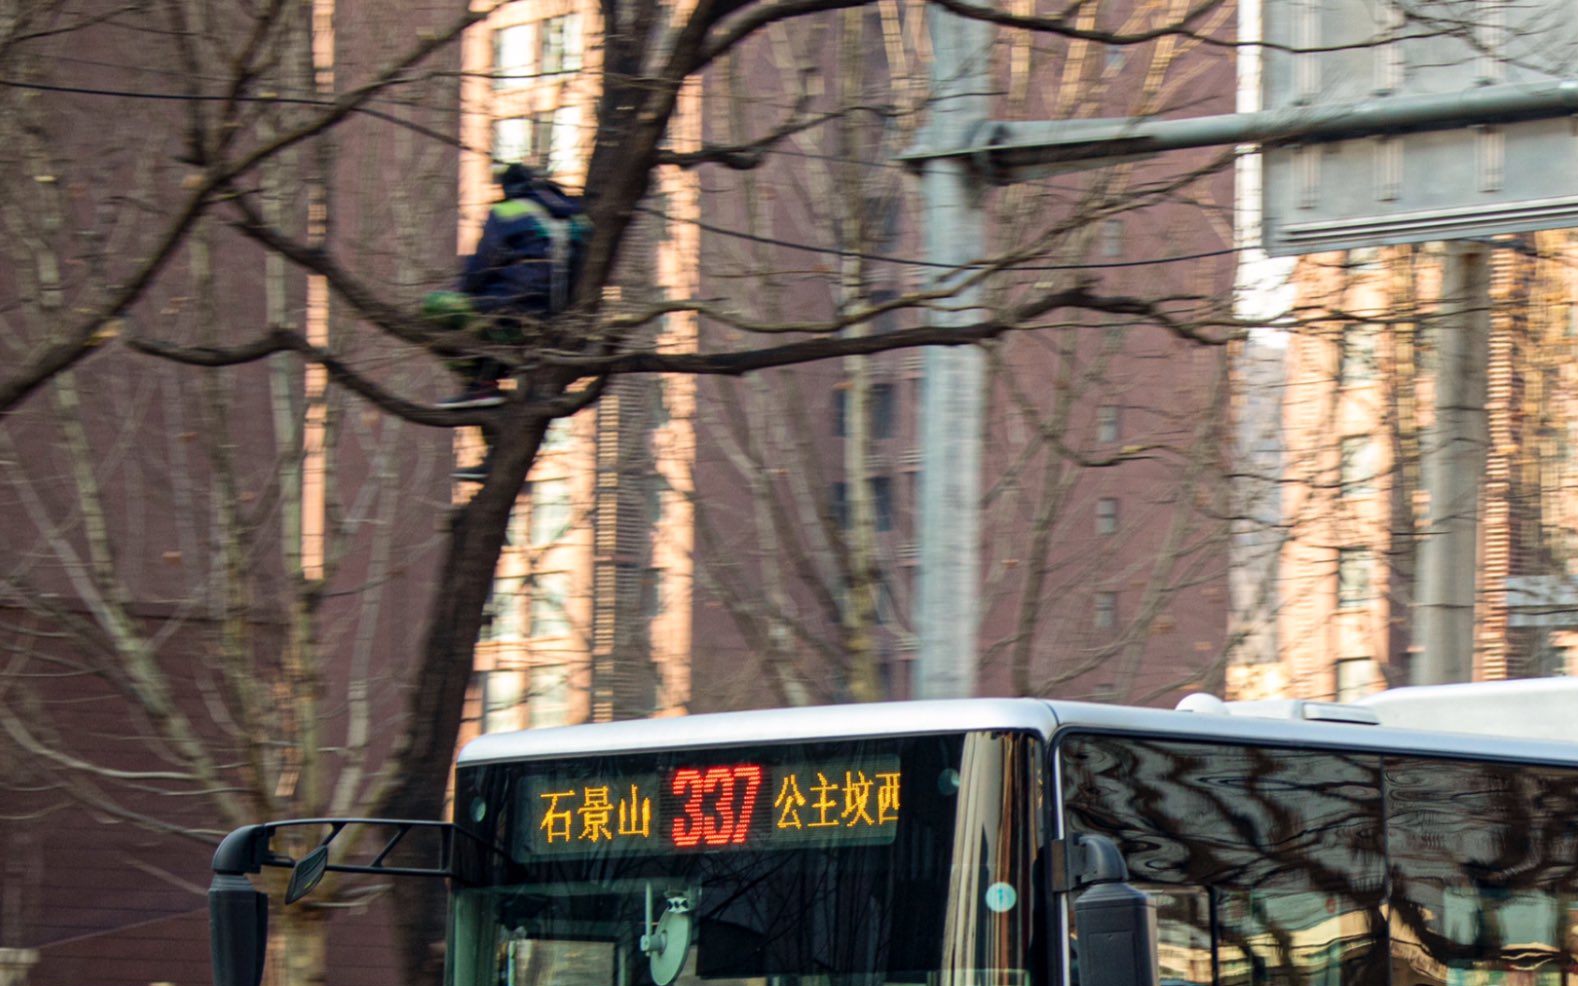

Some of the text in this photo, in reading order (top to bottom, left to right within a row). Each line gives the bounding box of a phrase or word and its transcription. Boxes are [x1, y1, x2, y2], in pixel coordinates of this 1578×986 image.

[540, 784, 651, 844] 石景山
[671, 765, 763, 847] 337
[774, 770, 901, 829] 公主坟西
